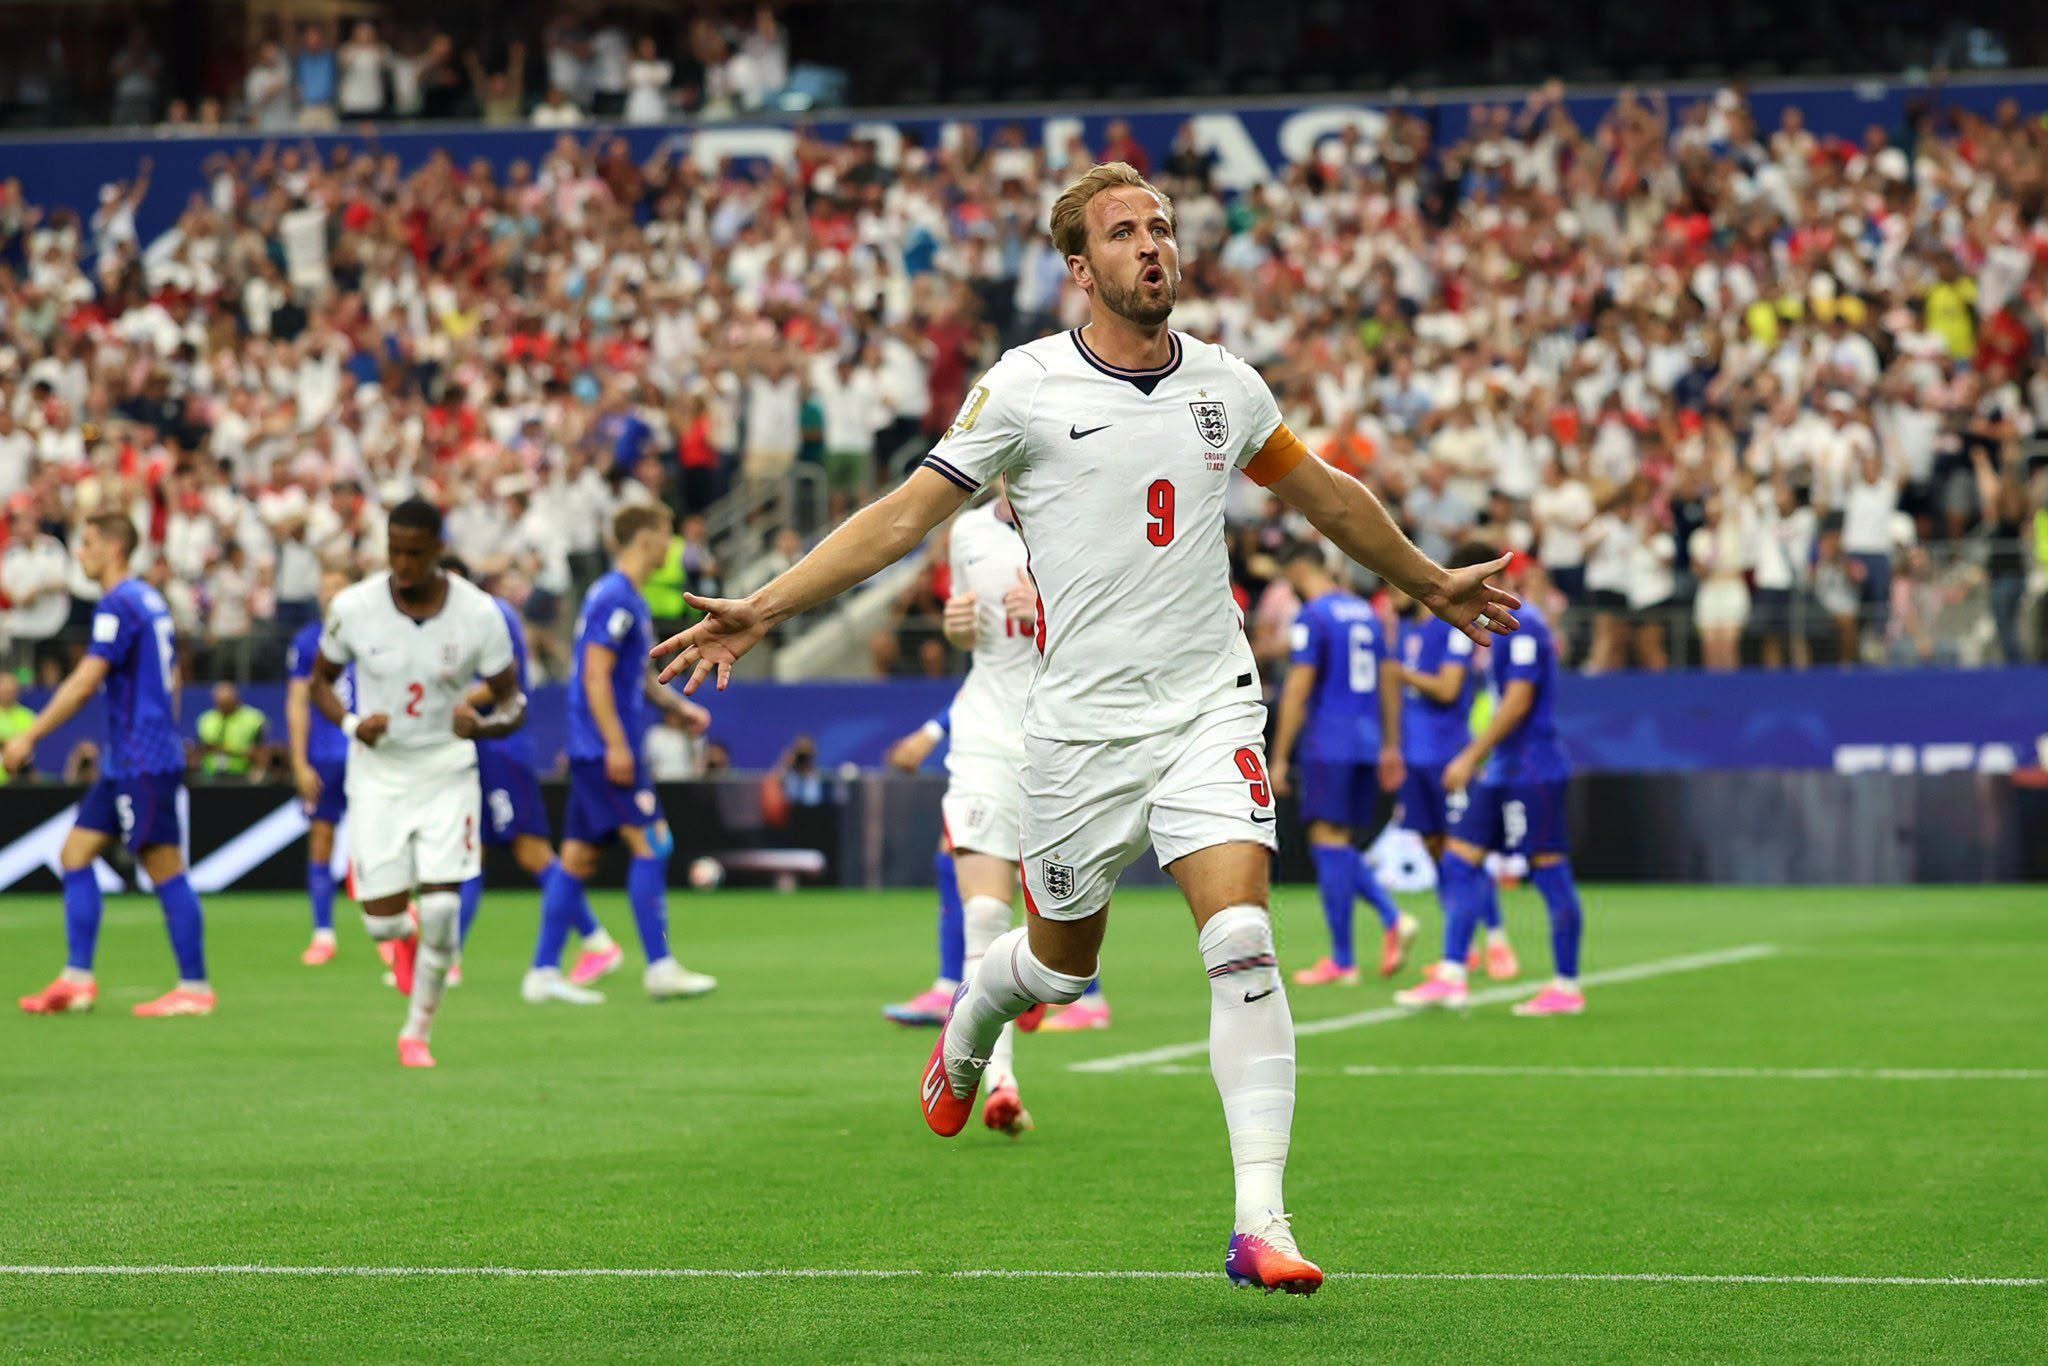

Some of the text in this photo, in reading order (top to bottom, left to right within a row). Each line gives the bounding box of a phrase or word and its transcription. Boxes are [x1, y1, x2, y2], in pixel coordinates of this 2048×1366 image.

[1147, 479, 1175, 547] 9
[1350, 623, 1376, 693] 6
[406, 683, 424, 718] 2
[1233, 747, 1270, 807] 9
